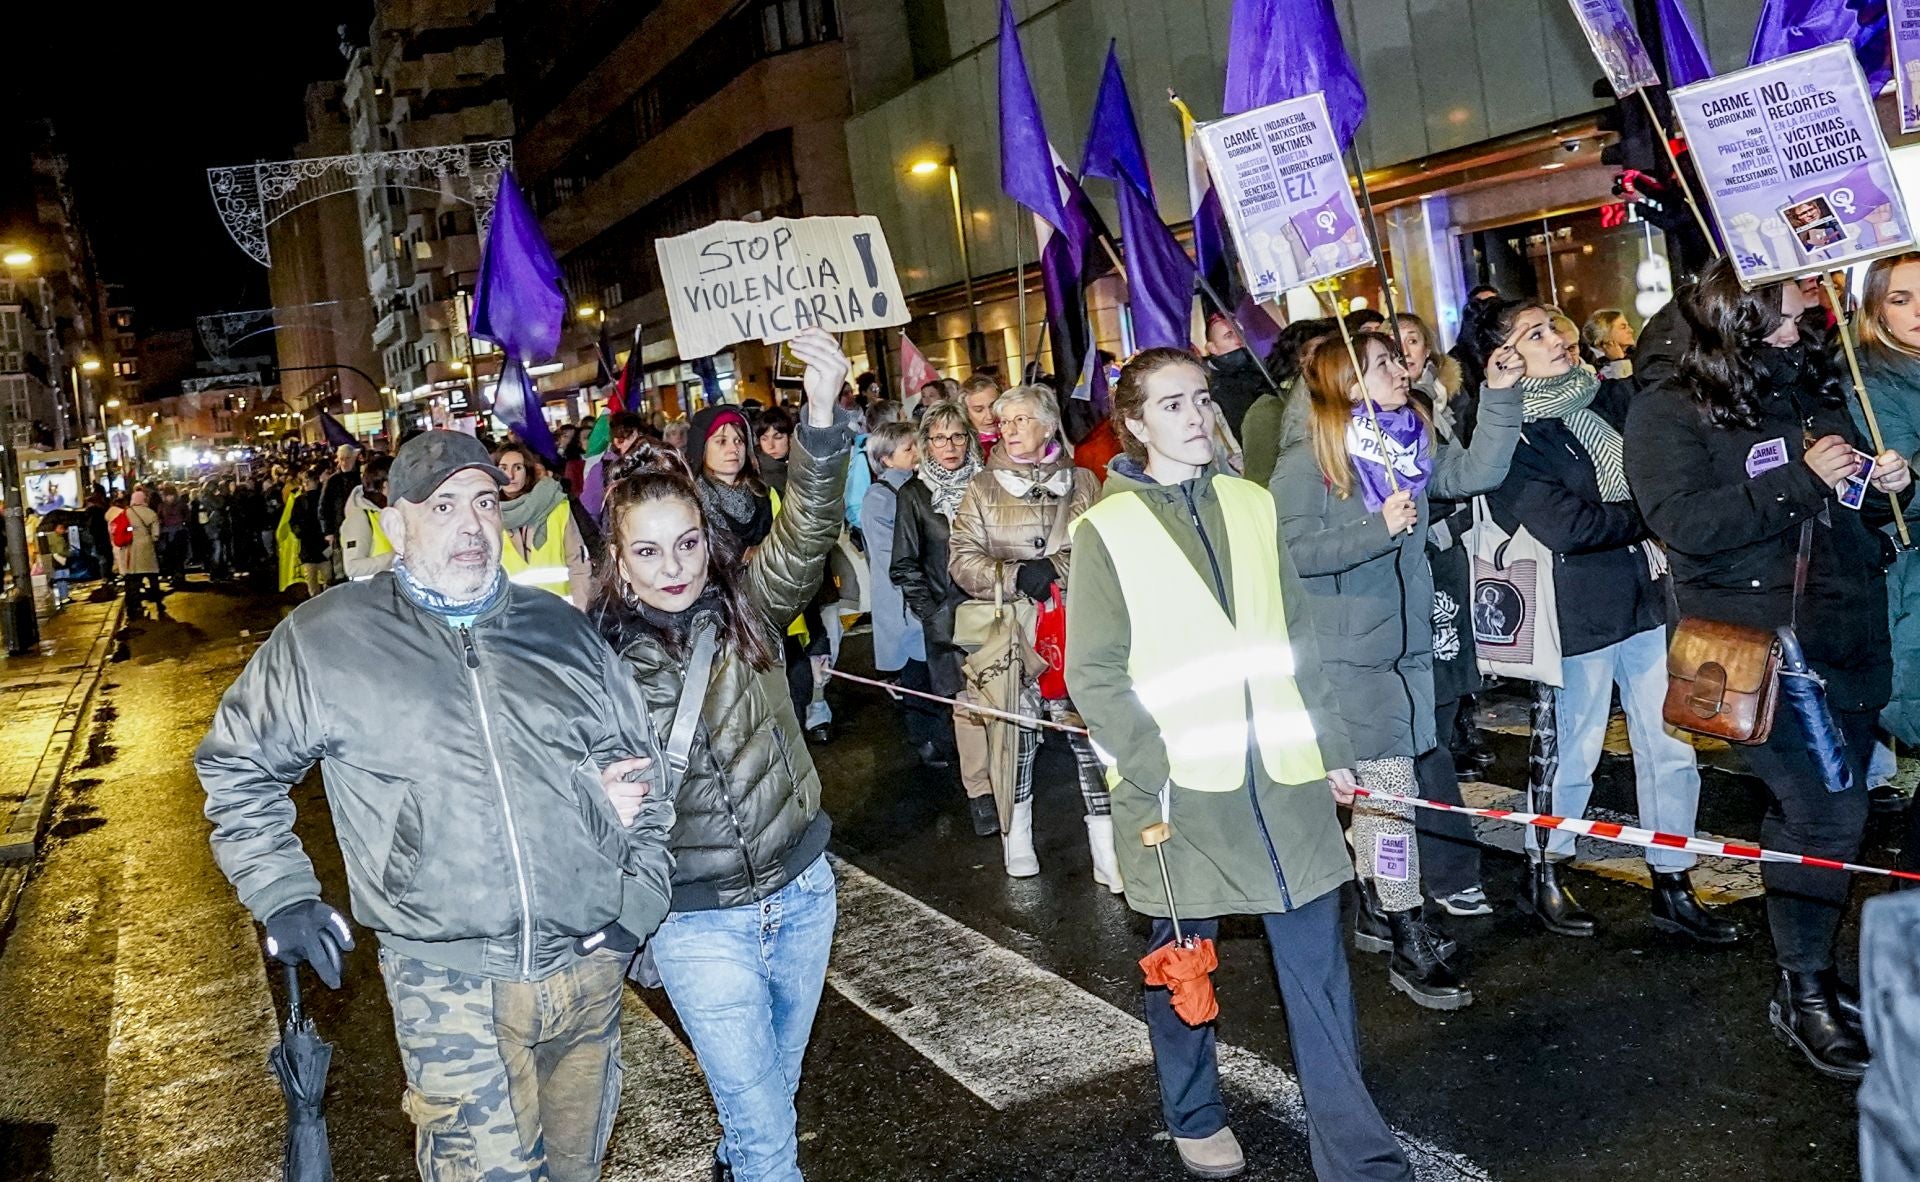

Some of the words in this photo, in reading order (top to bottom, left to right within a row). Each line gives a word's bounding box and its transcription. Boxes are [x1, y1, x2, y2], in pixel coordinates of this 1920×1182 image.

[1760, 81, 1789, 106] NO
[1791, 89, 1798, 99] A
[1798, 84, 1816, 96] LOS
[1701, 92, 1753, 118] CARME
[1768, 91, 1837, 120] RECORTES
[1264, 112, 1307, 132] INDARKERIA
[1707, 108, 1757, 129] BORROKAN!
[1773, 121, 1786, 132] EN
[1786, 117, 1798, 128] LA
[1223, 127, 1260, 149] CARME
[1268, 121, 1317, 143] MATXISTAREN
[1746, 127, 1763, 137] PARA
[1783, 116, 1845, 144] VÍCTIMAS
[1228, 141, 1263, 159] BORROKAN!
[1272, 135, 1313, 156] BIKTIMEN
[1718, 135, 1768, 156] PROTEGER
[1740, 150, 1754, 160] HAY
[1755, 146, 1770, 156] QUE
[1782, 128, 1862, 161] VIOLENCIA
[1276, 148, 1309, 166] ARRETAN
[1279, 152, 1335, 177] MURRIZKETARIK
[1731, 154, 1775, 174] AMPLIAR
[1789, 145, 1868, 179] MACHISTA
[1243, 181, 1276, 197] BENETAKO
[1283, 171, 1317, 202] EZ!
[1716, 182, 1761, 197] COMPROMISO
[699, 227, 792, 275] STOP
[1753, 446, 1777, 460] CARME
[1382, 839, 1404, 848] CARME
